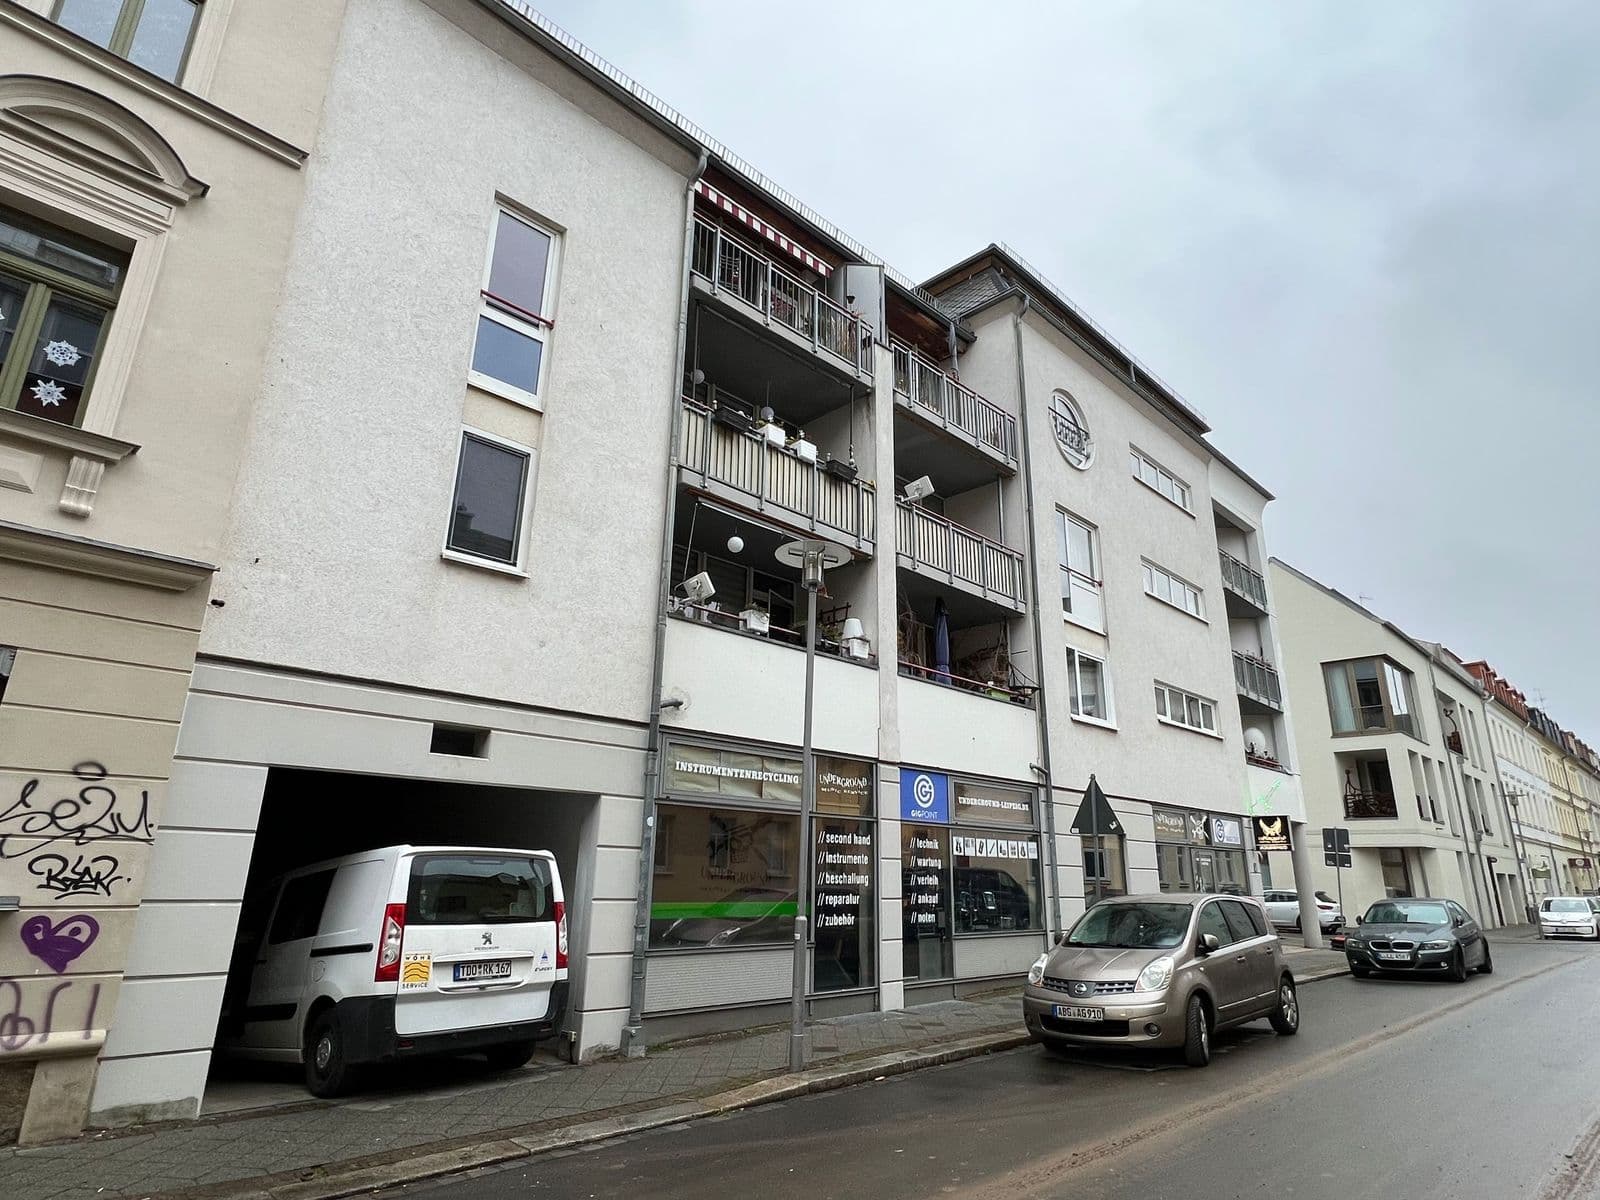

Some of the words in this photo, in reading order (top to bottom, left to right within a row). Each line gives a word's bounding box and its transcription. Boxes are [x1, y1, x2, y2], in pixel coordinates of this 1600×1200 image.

[675, 760, 799, 785] INSTRUMENTENRECYCLING
[819, 772, 868, 789] UNDERGROUND
[825, 833, 852, 844] second
[853, 833, 871, 845] hand
[916, 838, 939, 850] technik
[825, 851, 869, 865] instrumente
[916, 857, 942, 870] wartung
[825, 872, 869, 887] beschallung
[917, 874, 939, 886] verleih
[825, 893, 860, 907] reparatur
[824, 913, 855, 926] zubehör
[917, 912, 936, 924] noten
[461, 964, 477, 977] TDO
[483, 962, 494, 975] RK
[495, 962, 510, 974] 167
